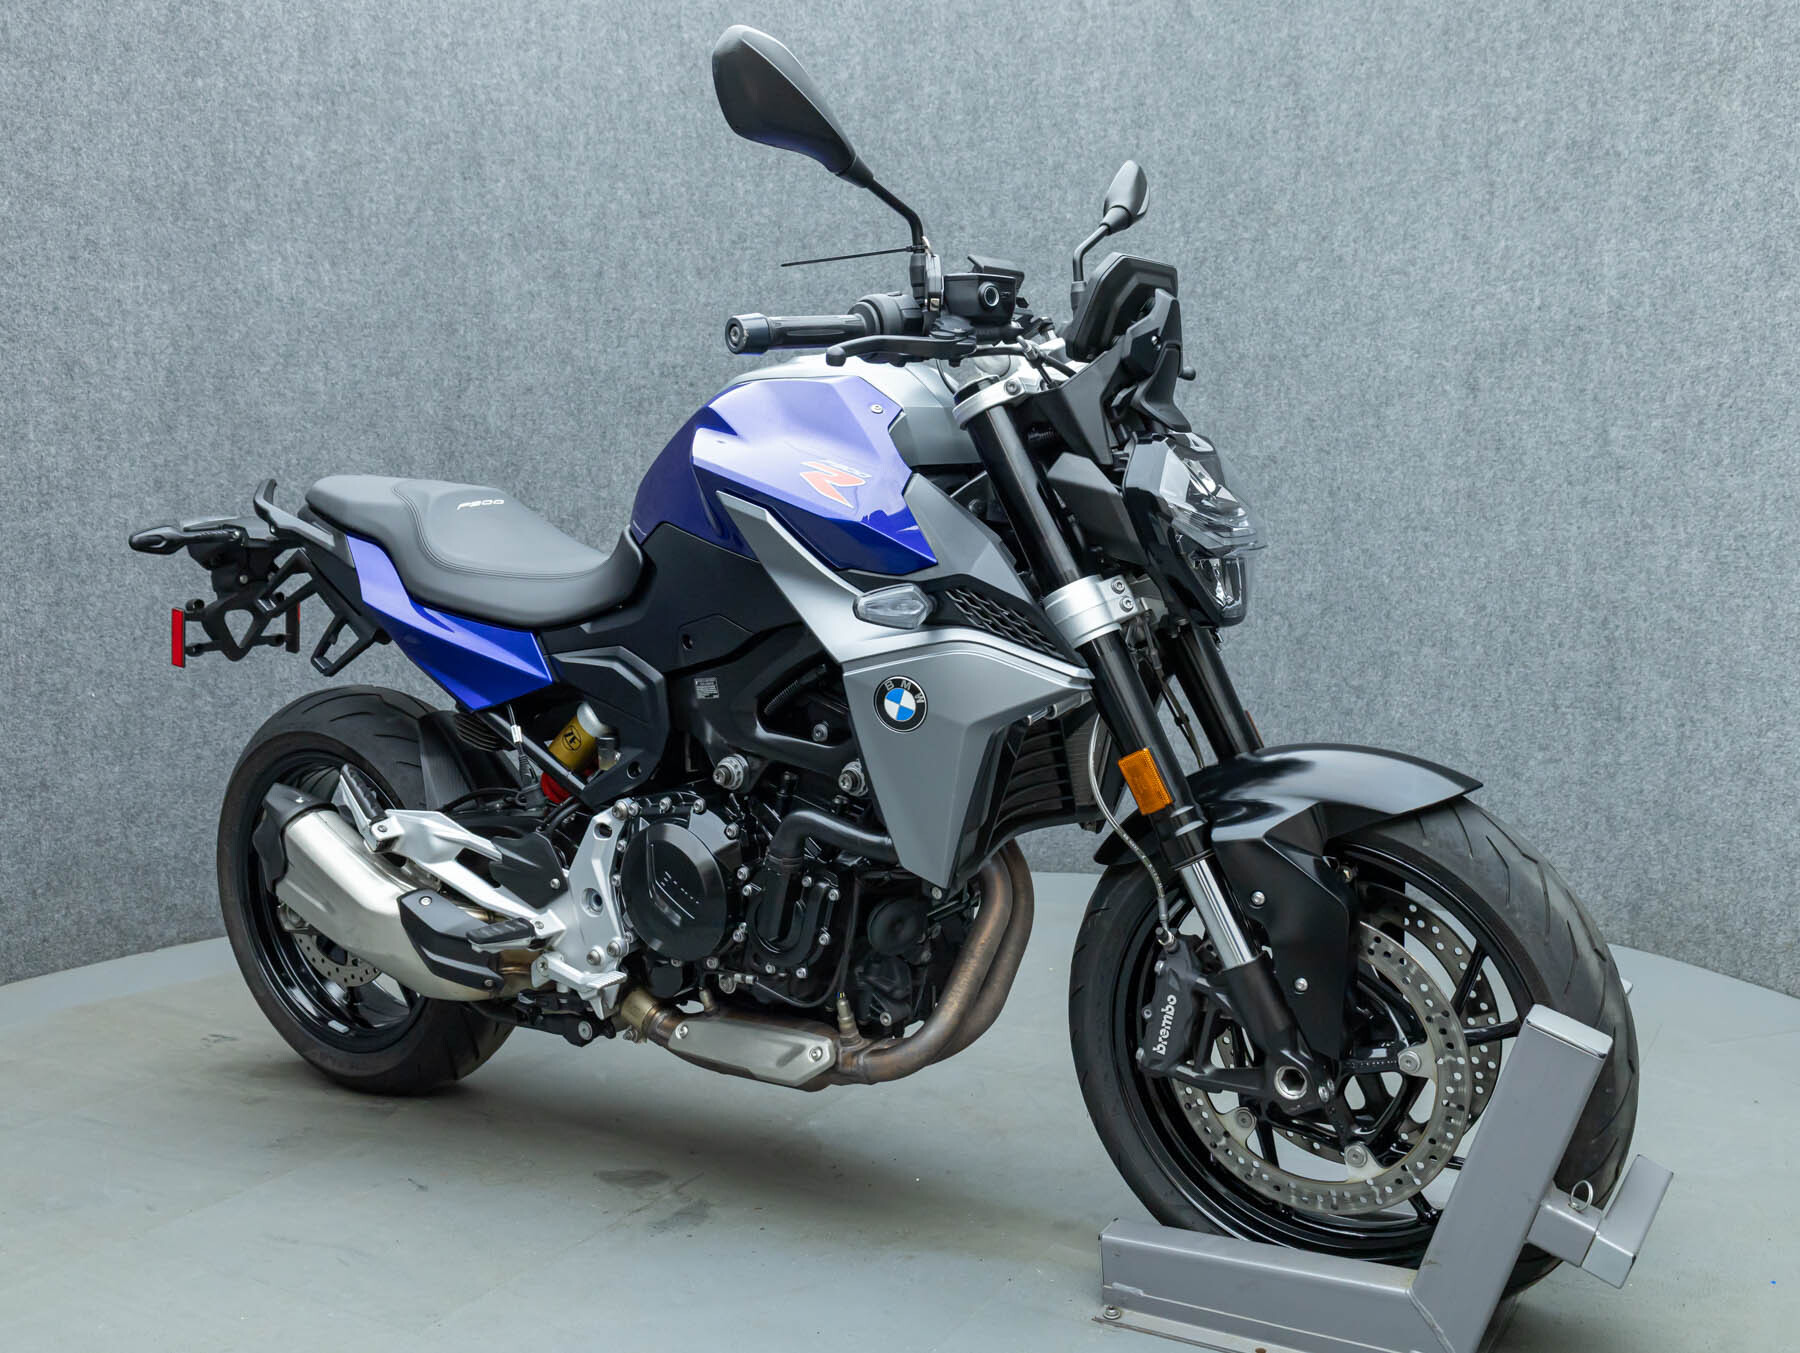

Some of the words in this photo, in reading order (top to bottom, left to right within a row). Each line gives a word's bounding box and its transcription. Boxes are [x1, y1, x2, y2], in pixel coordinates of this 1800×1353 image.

[800, 461, 867, 509] R
[884, 679, 925, 704] BMW
[1152, 994, 1177, 1055] brembo
